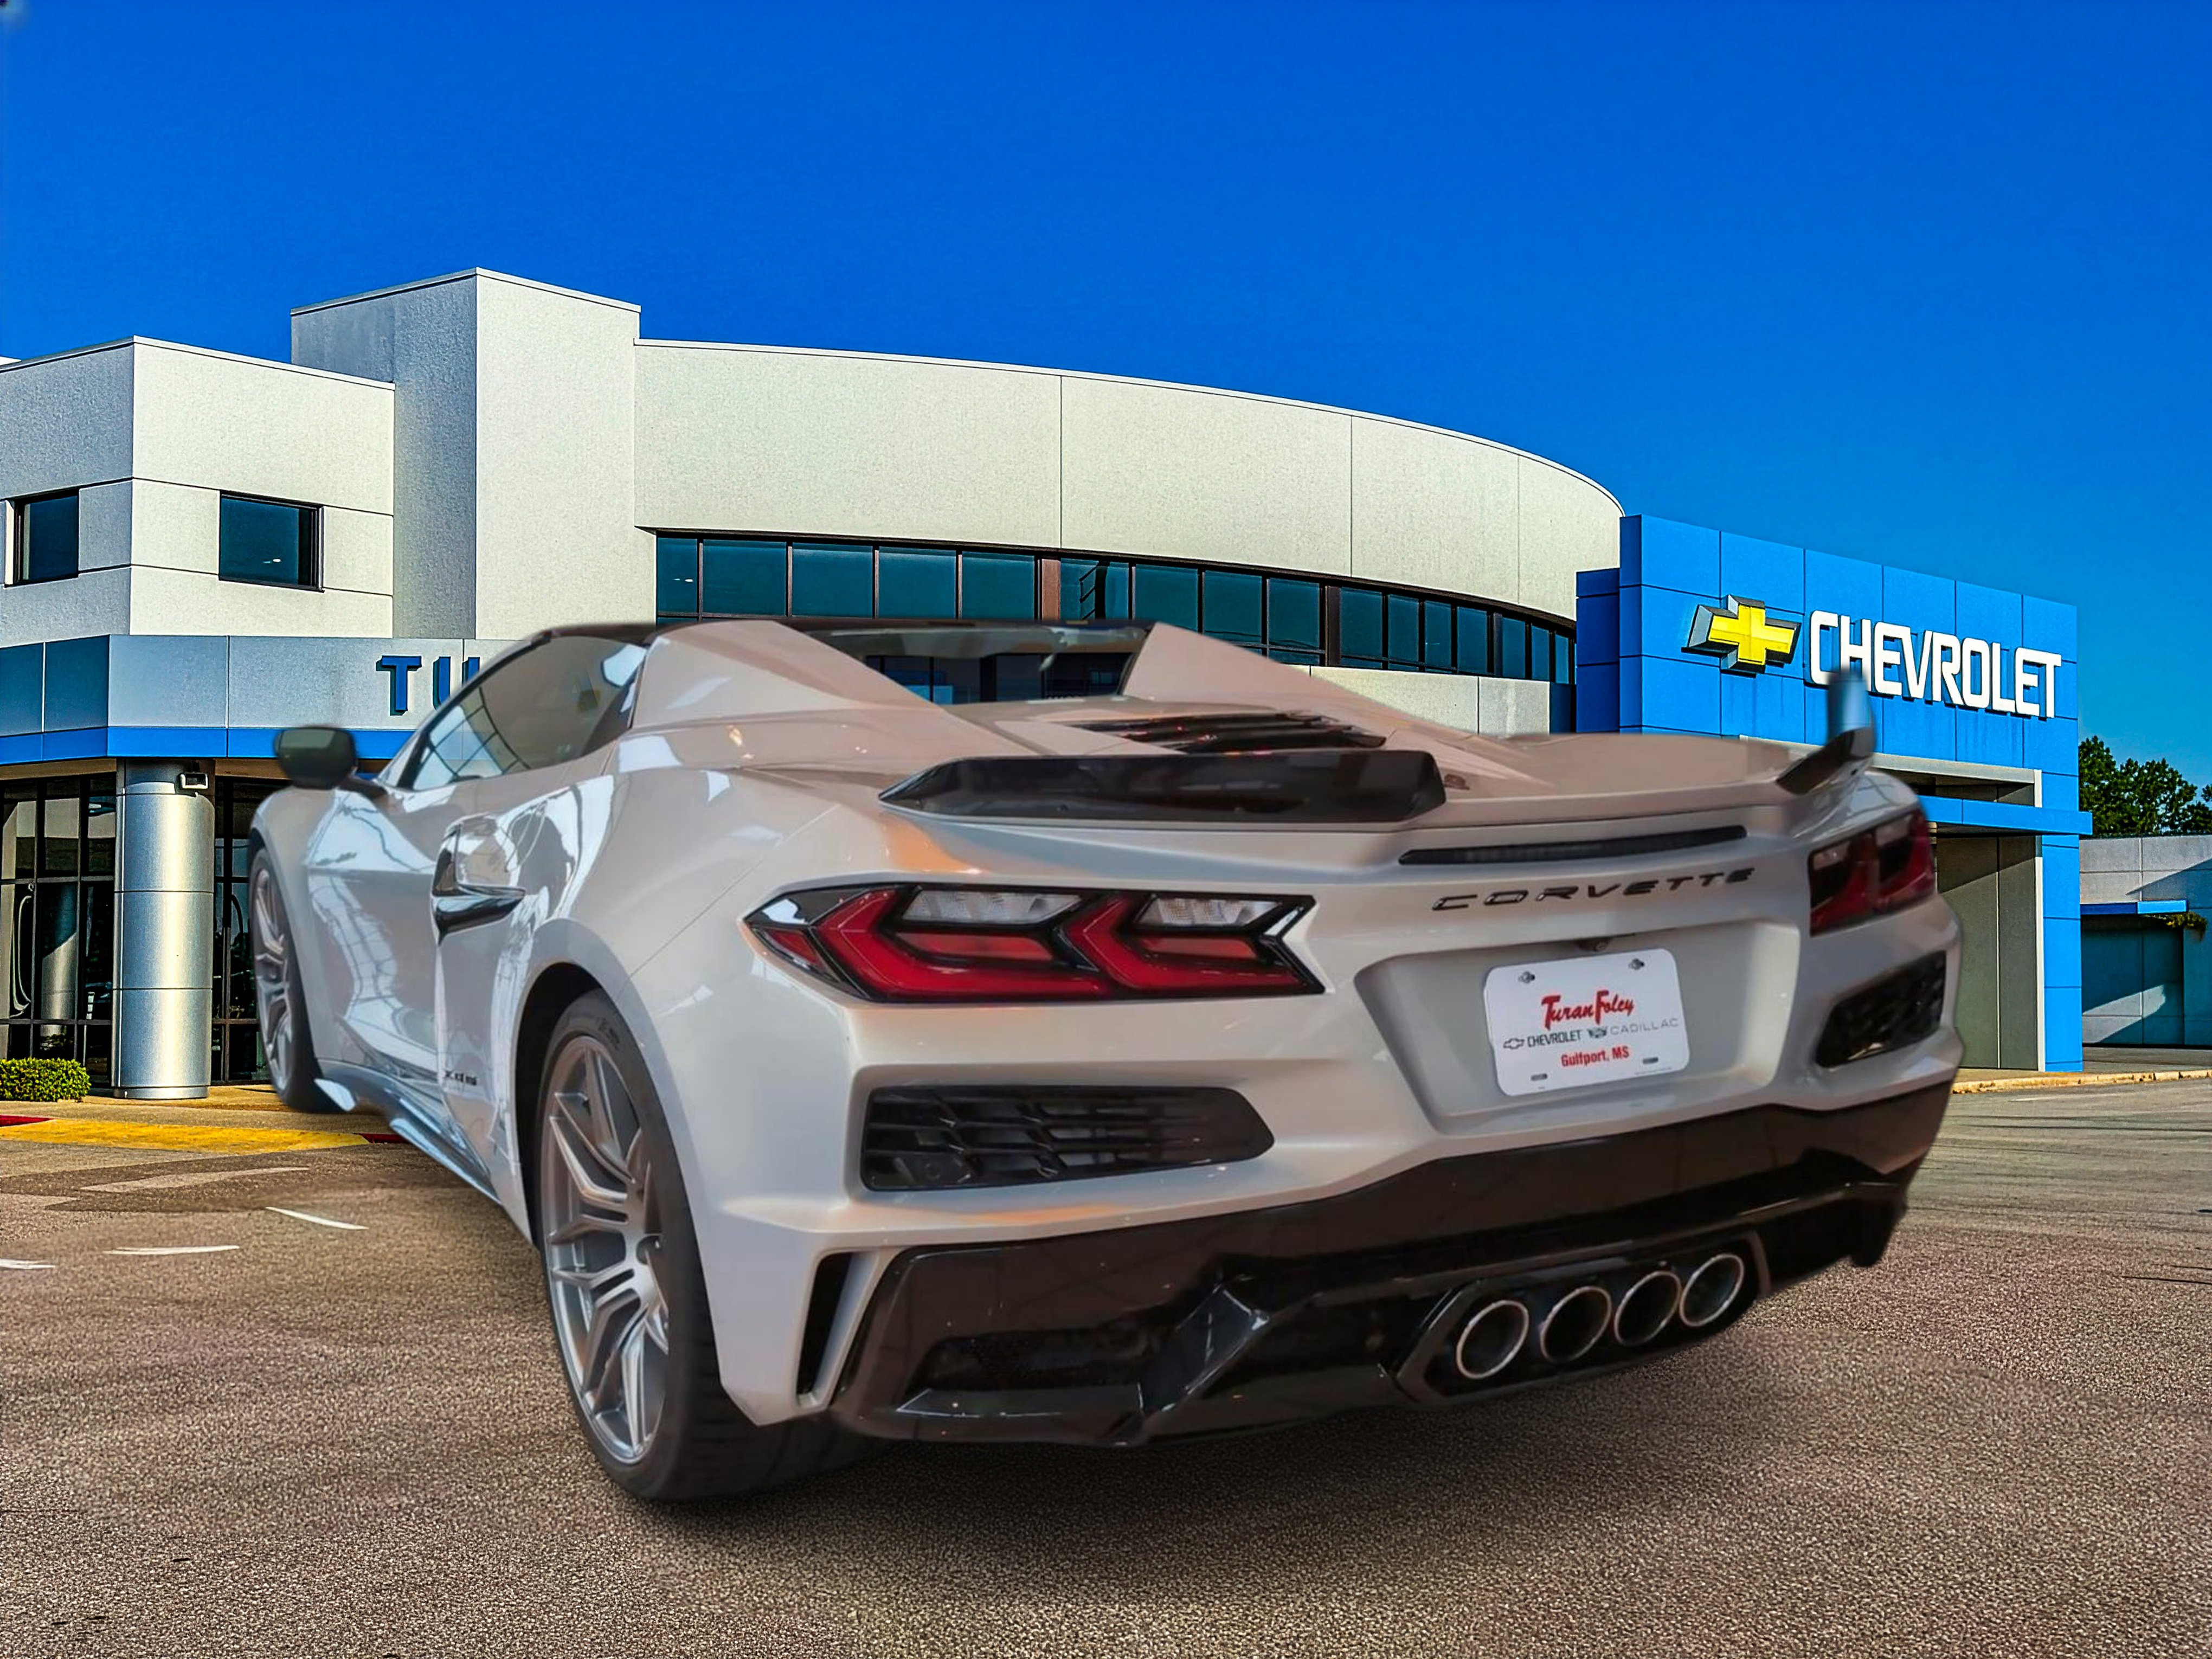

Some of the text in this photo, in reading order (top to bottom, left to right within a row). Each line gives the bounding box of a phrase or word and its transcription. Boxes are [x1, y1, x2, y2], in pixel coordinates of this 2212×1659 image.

[1811, 610, 2062, 718] CHEVROLET
[1432, 867, 1754, 910] CORVETTE
[1541, 990, 1634, 1031] Turan Foley
[1527, 1018, 1679, 1047] CHEVROLET CADILLAC
[1612, 1046, 1629, 1059] MS
